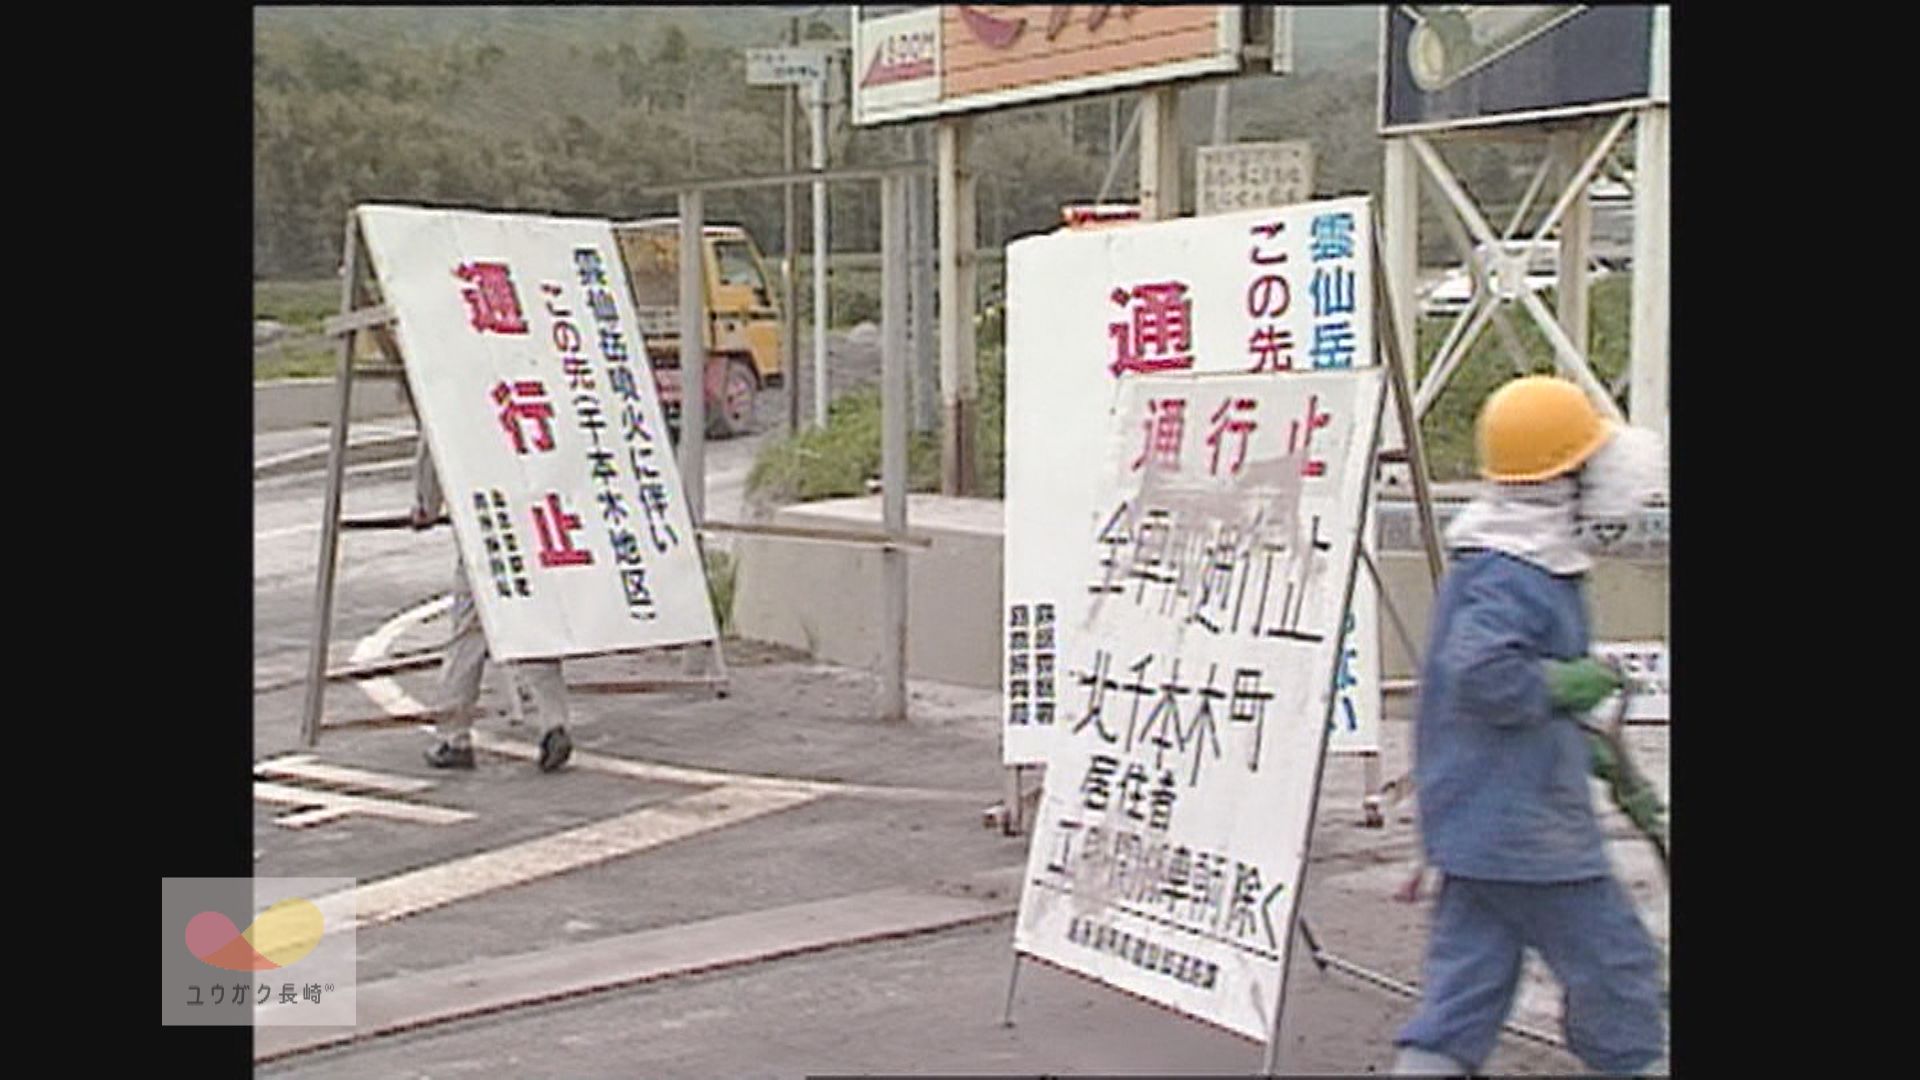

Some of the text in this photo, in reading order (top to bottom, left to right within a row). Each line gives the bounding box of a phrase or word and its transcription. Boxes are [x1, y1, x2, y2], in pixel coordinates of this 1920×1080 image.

[1108, 280, 1194, 376] 通
[1248, 222, 1295, 373] この先
[1309, 212, 1355, 370] 雲仙岳
[452, 261, 595, 568] 通行止
[573, 248, 679, 553] 雲仙岳噴火に伴い
[1131, 394, 1334, 480] 通行止
[1073, 648, 1276, 787] 北千本木町
[1081, 755, 1179, 831] 居住者
